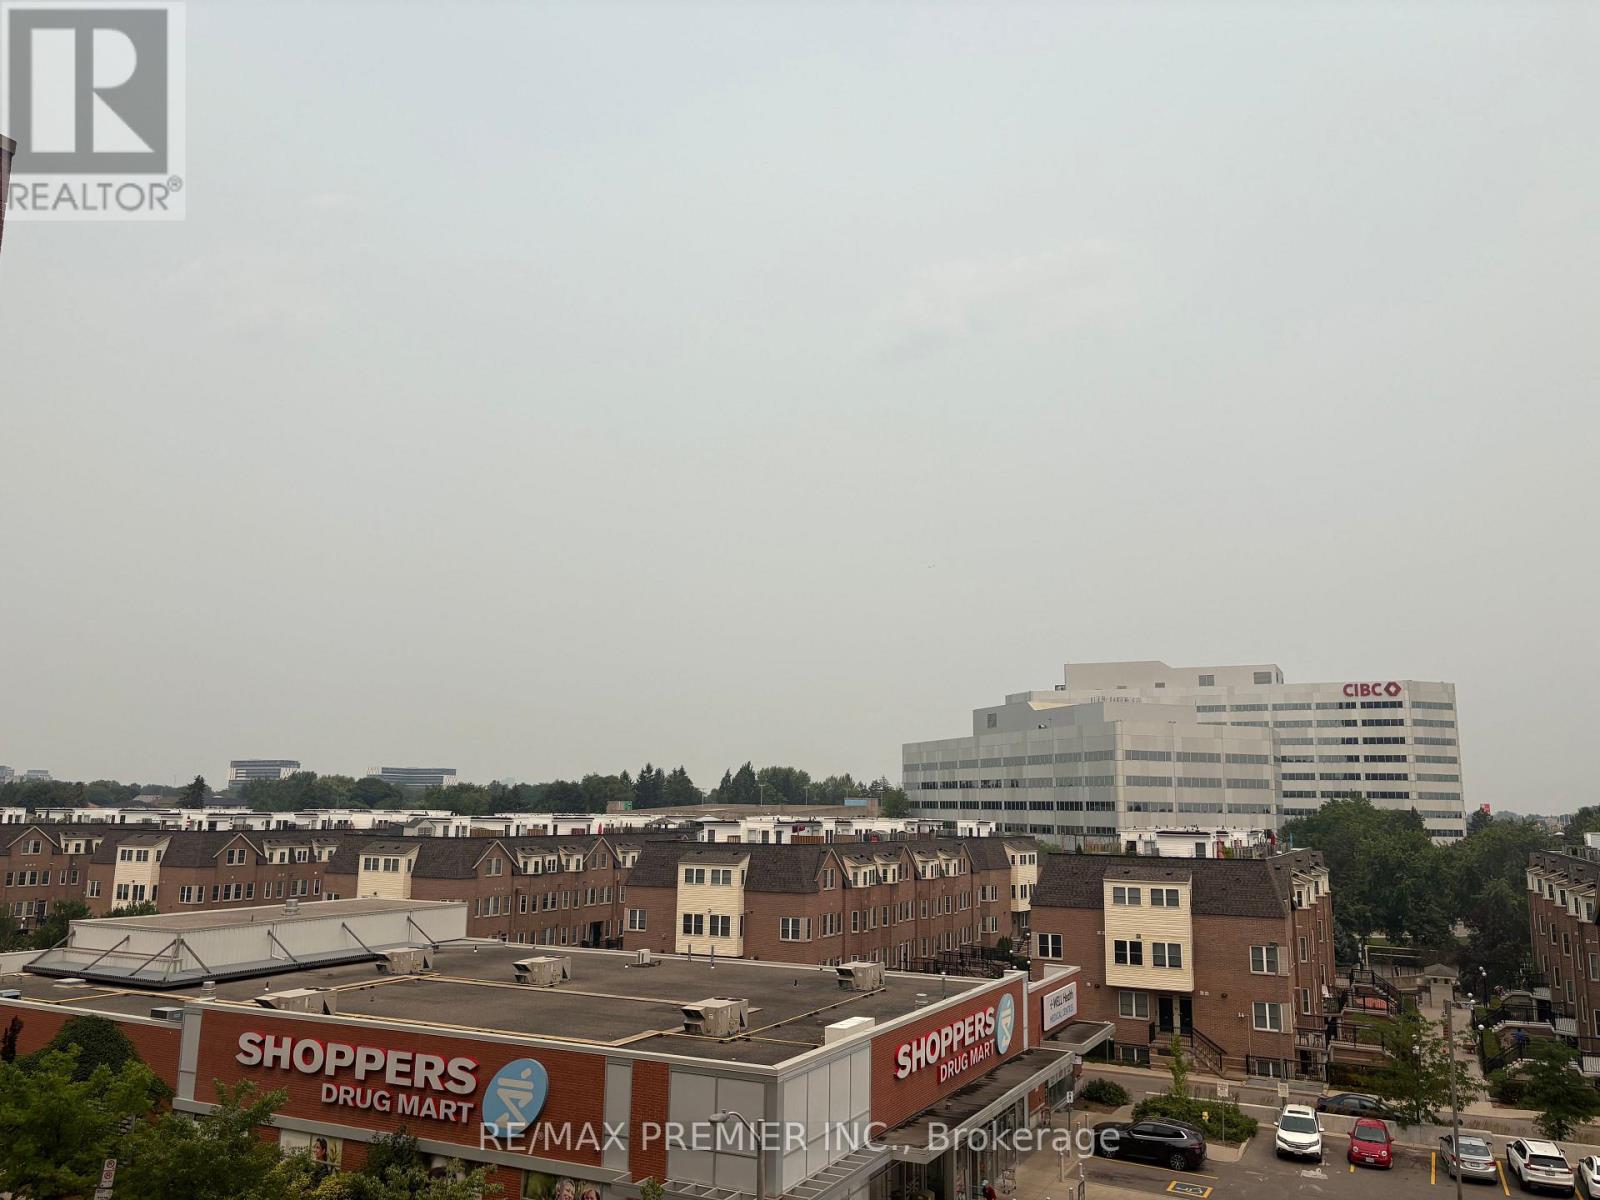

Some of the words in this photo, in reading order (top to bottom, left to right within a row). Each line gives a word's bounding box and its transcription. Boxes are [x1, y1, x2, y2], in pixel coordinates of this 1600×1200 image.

[1343, 683, 1382, 697] CIBC
[235, 1031, 479, 1094] SHOPPERS
[896, 1006, 995, 1079] SHOPPERS
[940, 1053, 968, 1083] DRUG
[970, 1038, 995, 1067] MART
[321, 1082, 391, 1113] DRUG
[397, 1093, 474, 1123] MART
